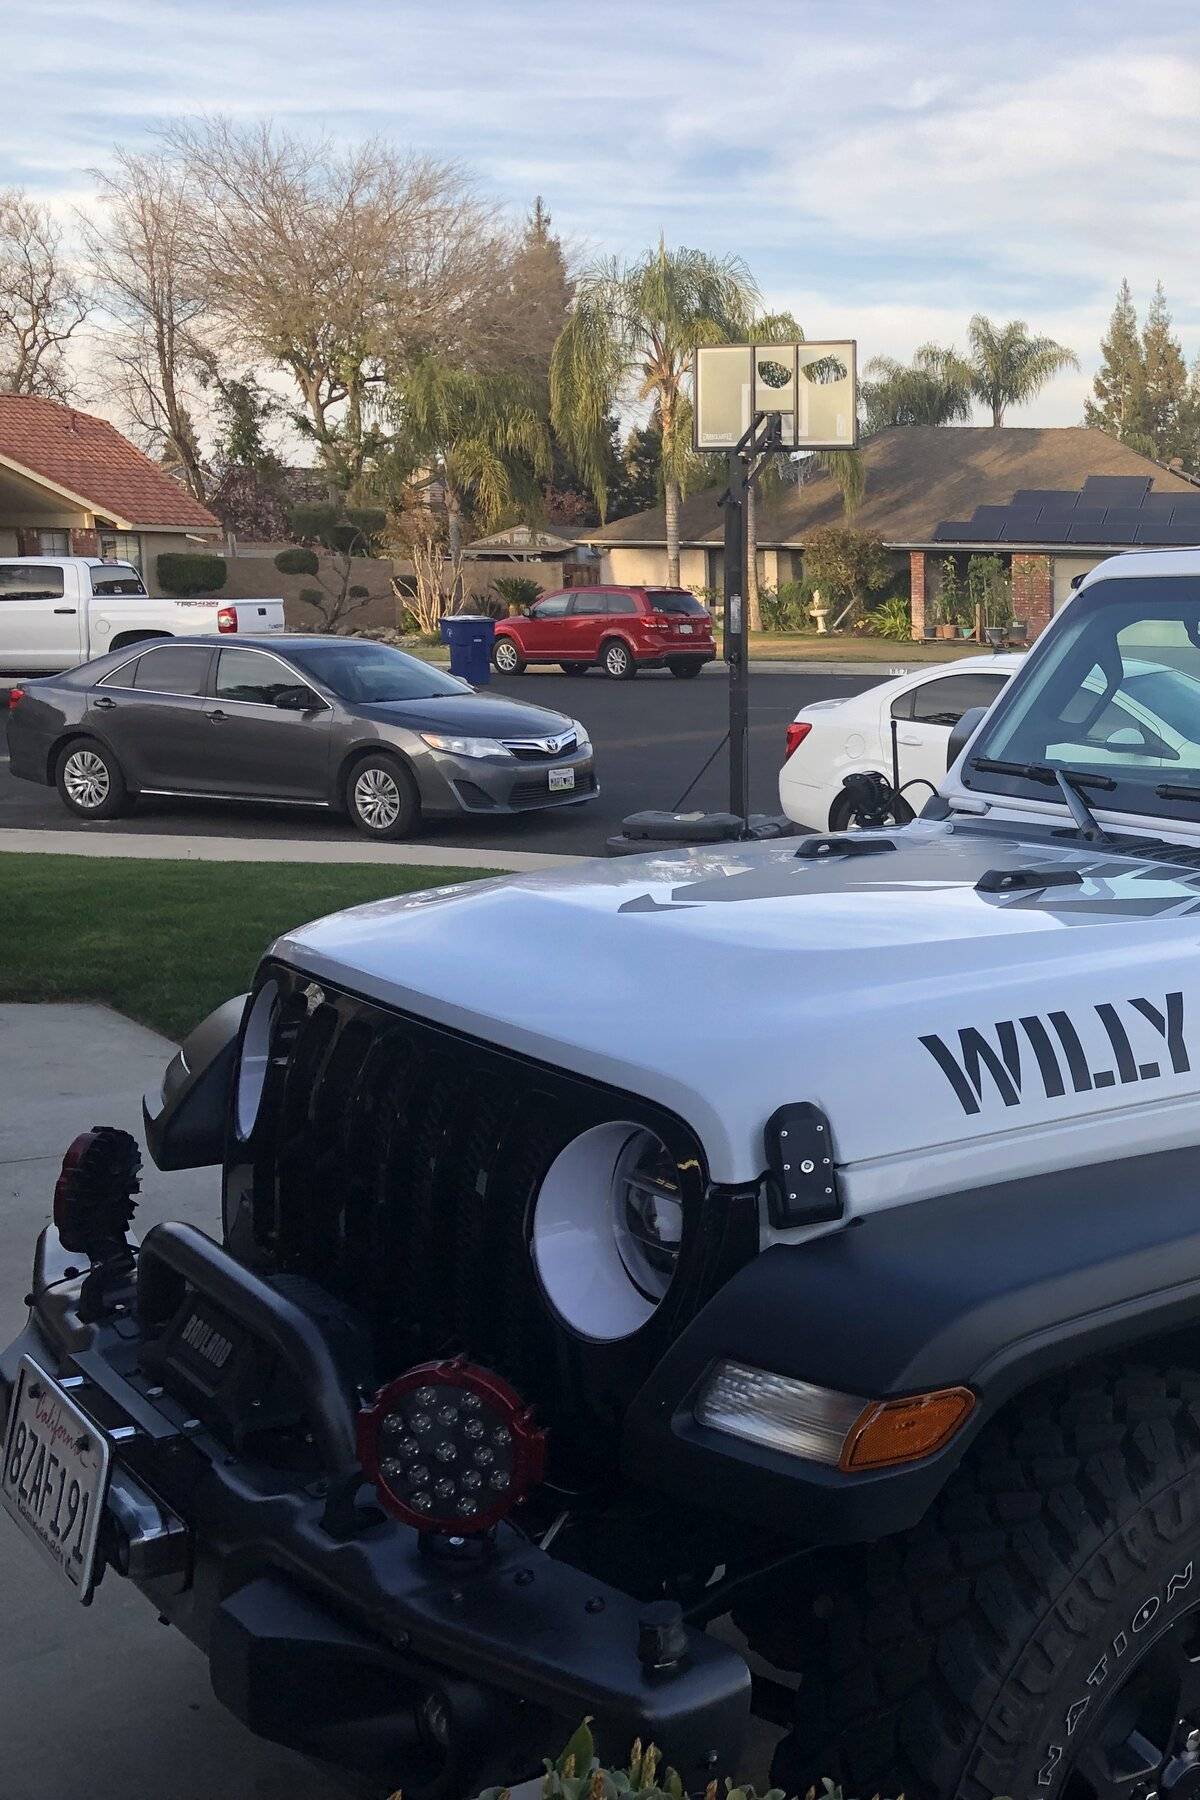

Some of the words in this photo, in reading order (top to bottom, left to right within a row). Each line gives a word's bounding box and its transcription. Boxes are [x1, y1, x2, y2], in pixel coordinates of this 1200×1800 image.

[917, 991, 1191, 1115] WILLY
[9, 1421, 90, 1566] 8ZAF191
[1030, 1560, 1194, 1800] NATION
